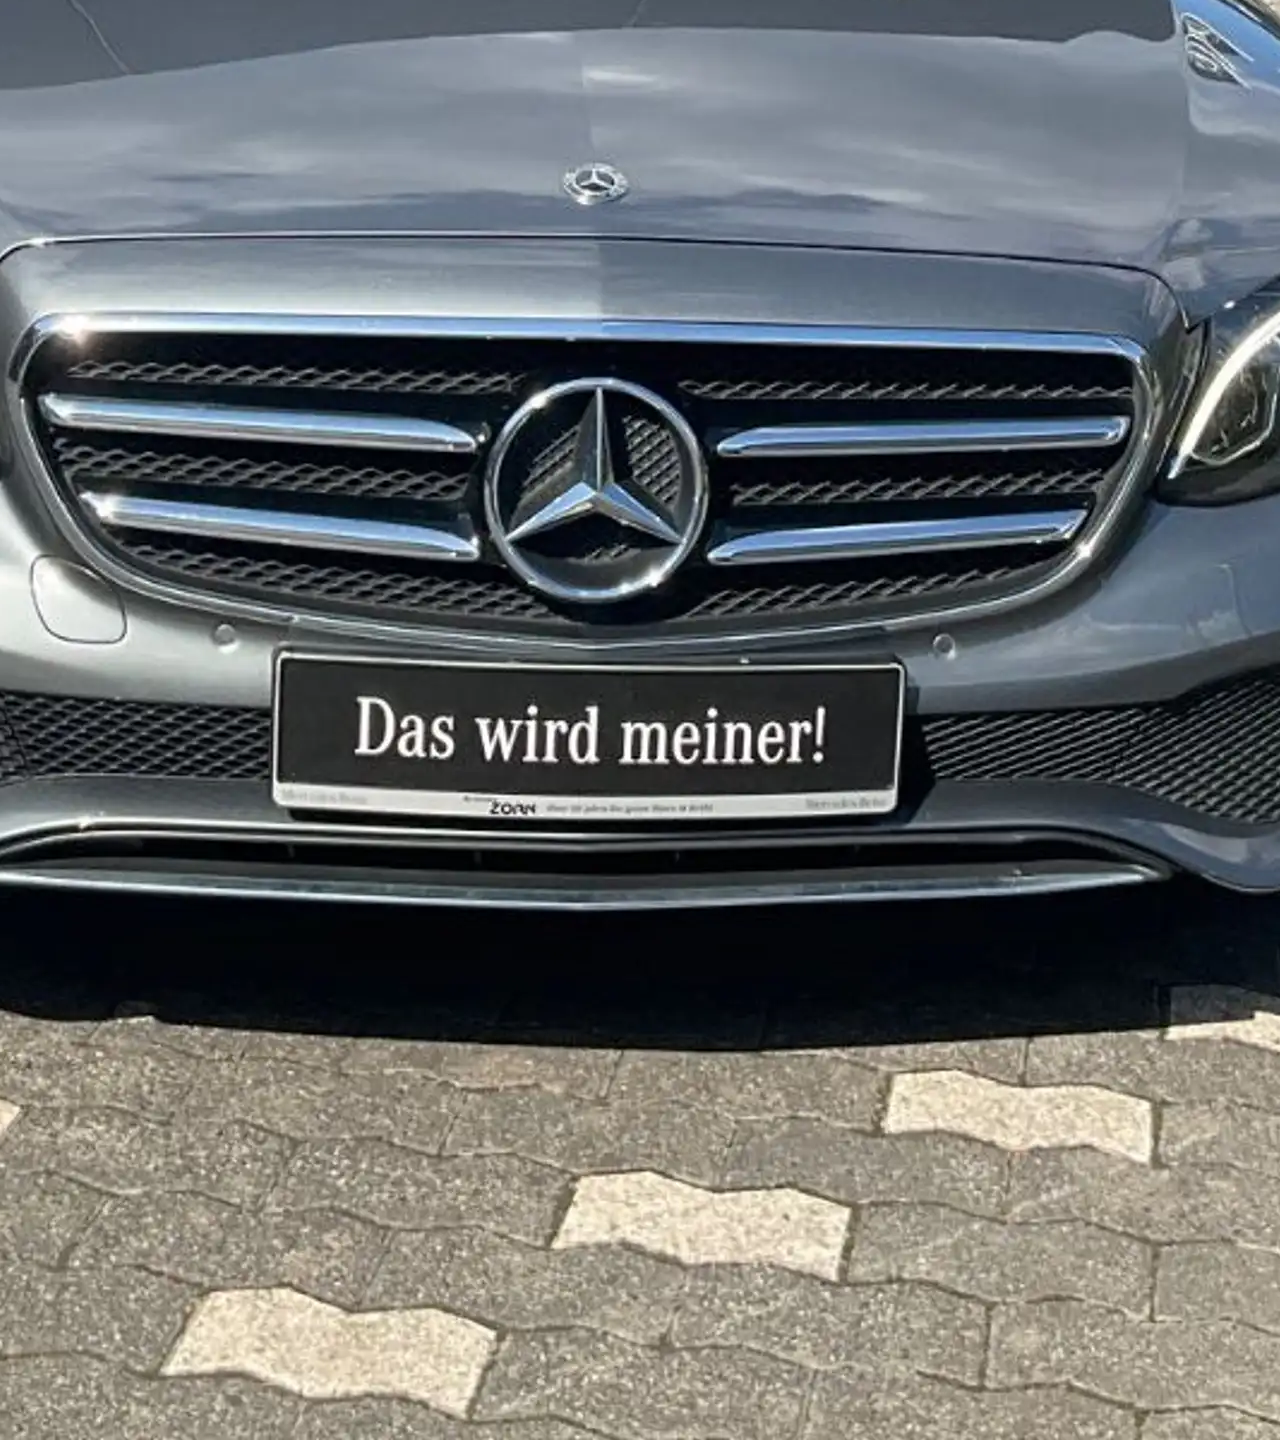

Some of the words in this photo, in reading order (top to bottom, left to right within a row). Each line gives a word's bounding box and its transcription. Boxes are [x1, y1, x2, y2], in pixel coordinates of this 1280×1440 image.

[354, 696, 455, 760] Das
[474, 704, 600, 764] wird
[618, 706, 826, 765] meiner!
